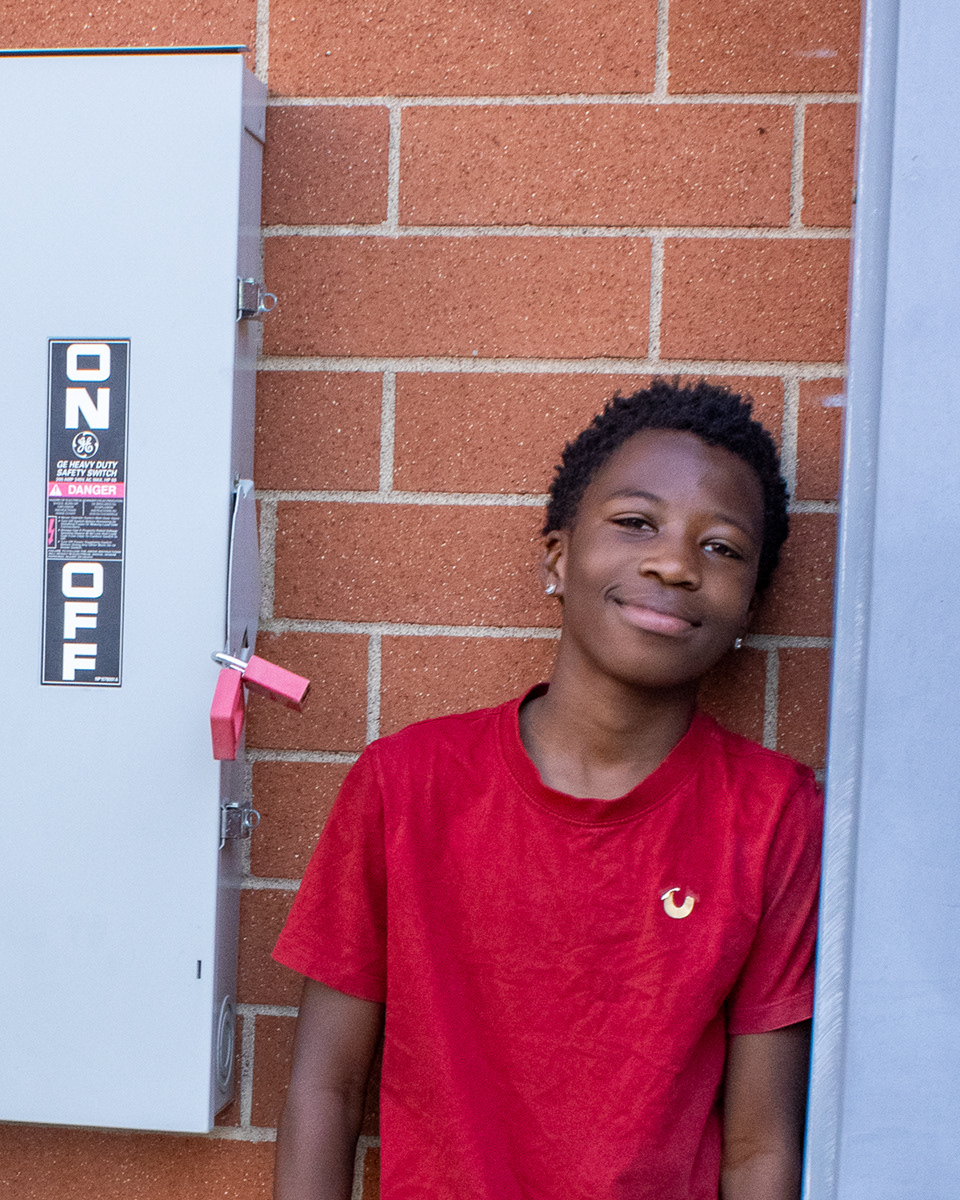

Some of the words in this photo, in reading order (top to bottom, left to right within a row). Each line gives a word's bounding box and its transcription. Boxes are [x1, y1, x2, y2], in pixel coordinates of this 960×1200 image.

[65, 343, 111, 430] ON
[56, 460, 68, 469] GE
[69, 460, 95, 469] HEAVY
[95, 461, 119, 469] DUTY
[56, 469, 86, 477] SAFETY
[86, 469, 118, 477] SWITCH
[68, 484, 117, 495] DANGER
[62, 562, 104, 681] OFF
